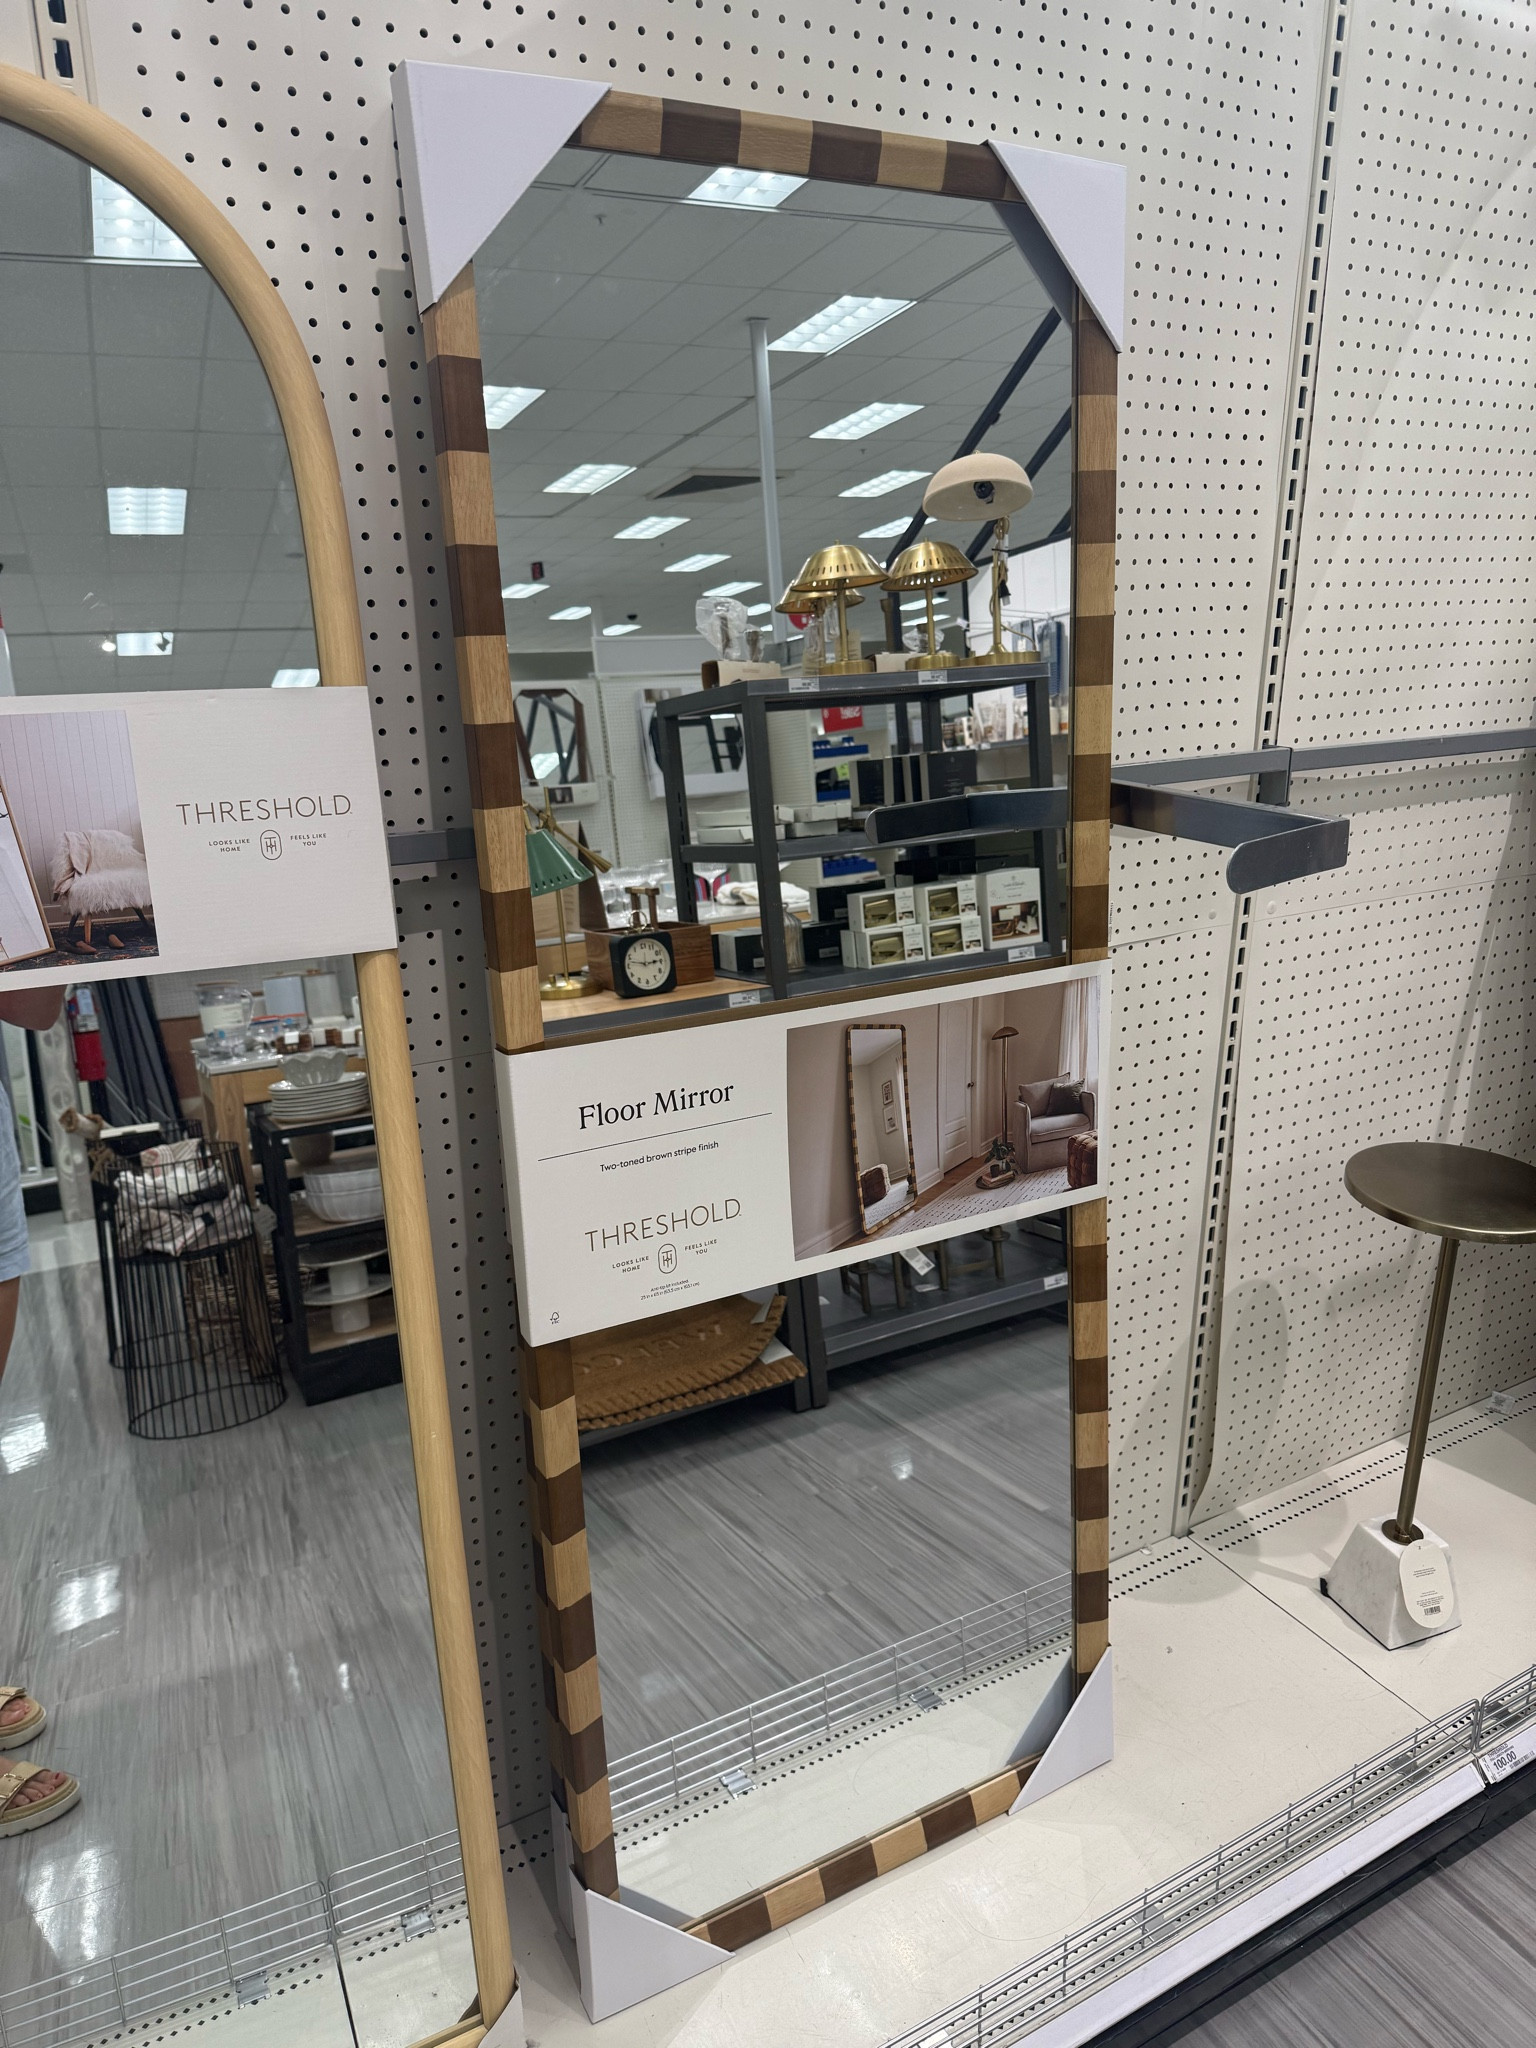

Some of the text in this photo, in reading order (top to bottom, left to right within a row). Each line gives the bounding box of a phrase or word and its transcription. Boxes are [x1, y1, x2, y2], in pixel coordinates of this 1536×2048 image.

[176, 795, 352, 826] THRESHOLD
[208, 839, 233, 847] LOOKS
[578, 1084, 735, 1130] Floor Mirror
[600, 1141, 719, 1172] Two-toned brown stripe finish
[585, 1198, 742, 1252] THRESHOLD
[684, 1239, 718, 1251] FEELS LIKE
[612, 1255, 650, 1269] LOOKS LIKE
[622, 1264, 641, 1273] HOME
[1493, 1751, 1517, 1770] 100.00
